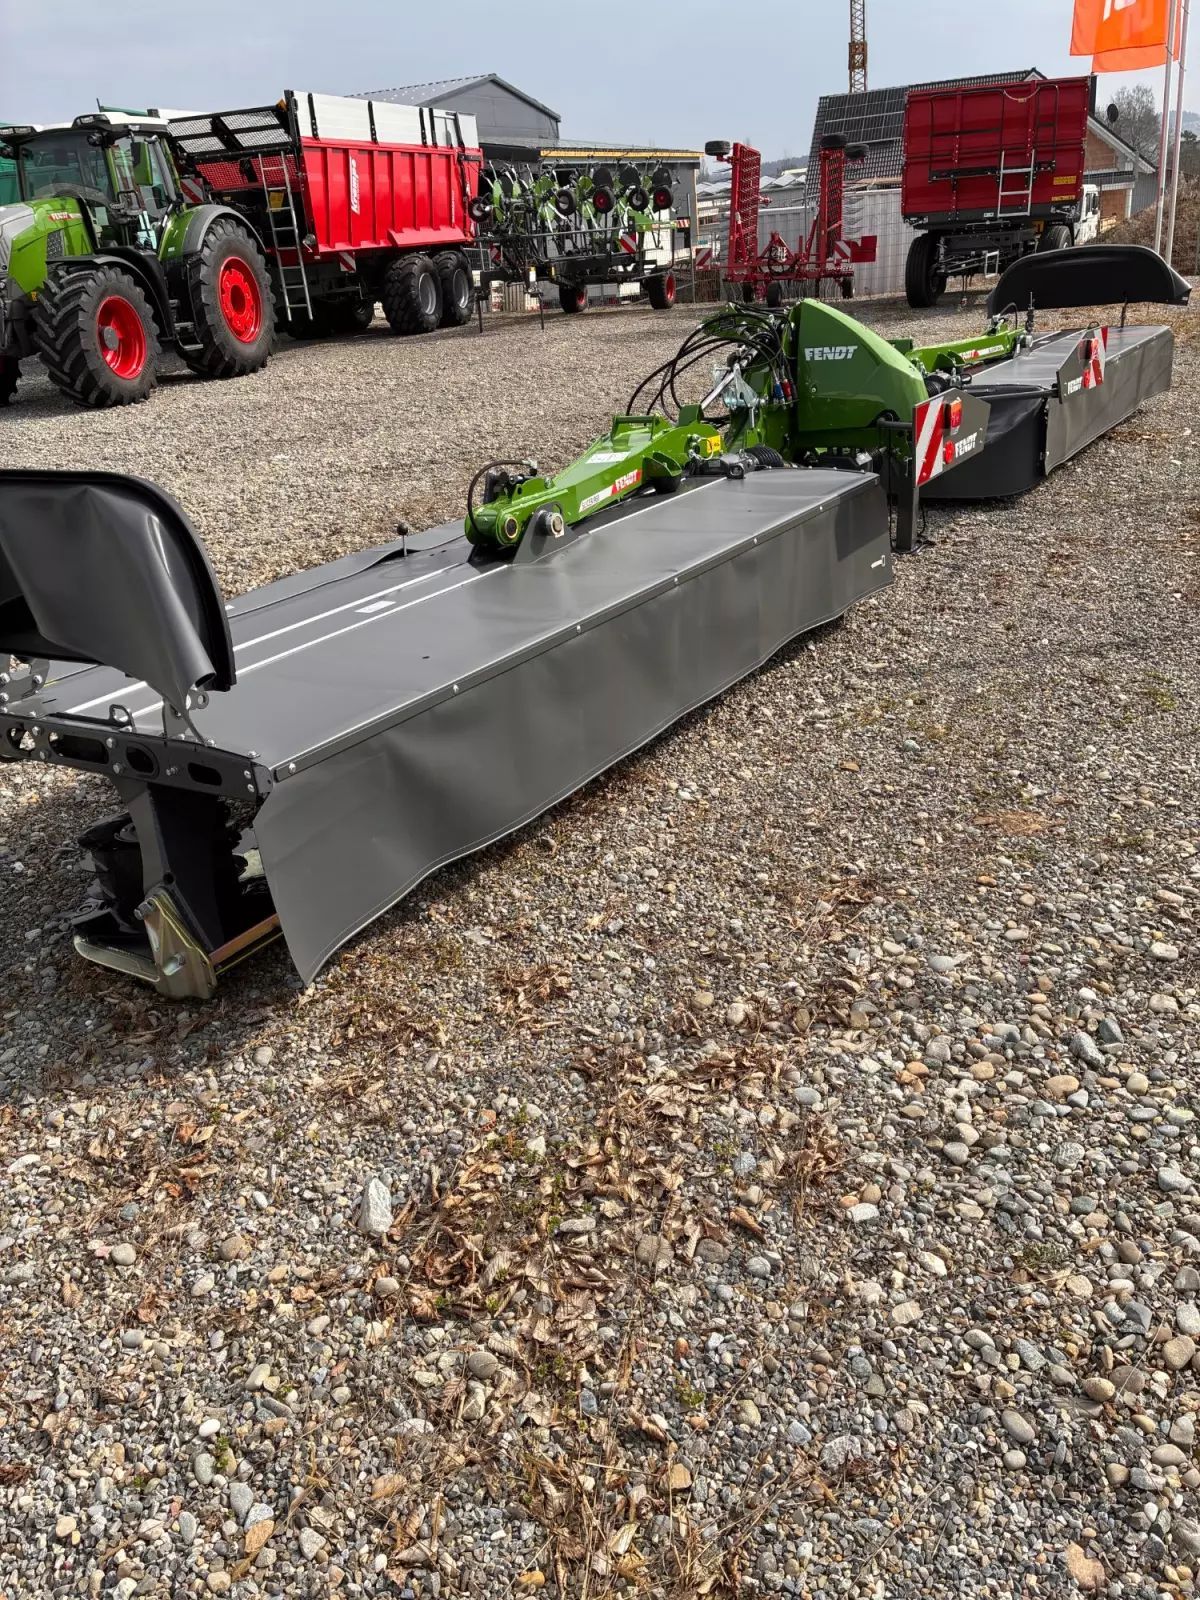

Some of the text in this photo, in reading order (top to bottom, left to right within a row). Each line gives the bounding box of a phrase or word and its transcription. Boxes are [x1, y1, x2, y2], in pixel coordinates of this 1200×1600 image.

[804, 345, 858, 361] FENDT
[954, 432, 978, 458] FENDT
[615, 468, 638, 491] FENDT
